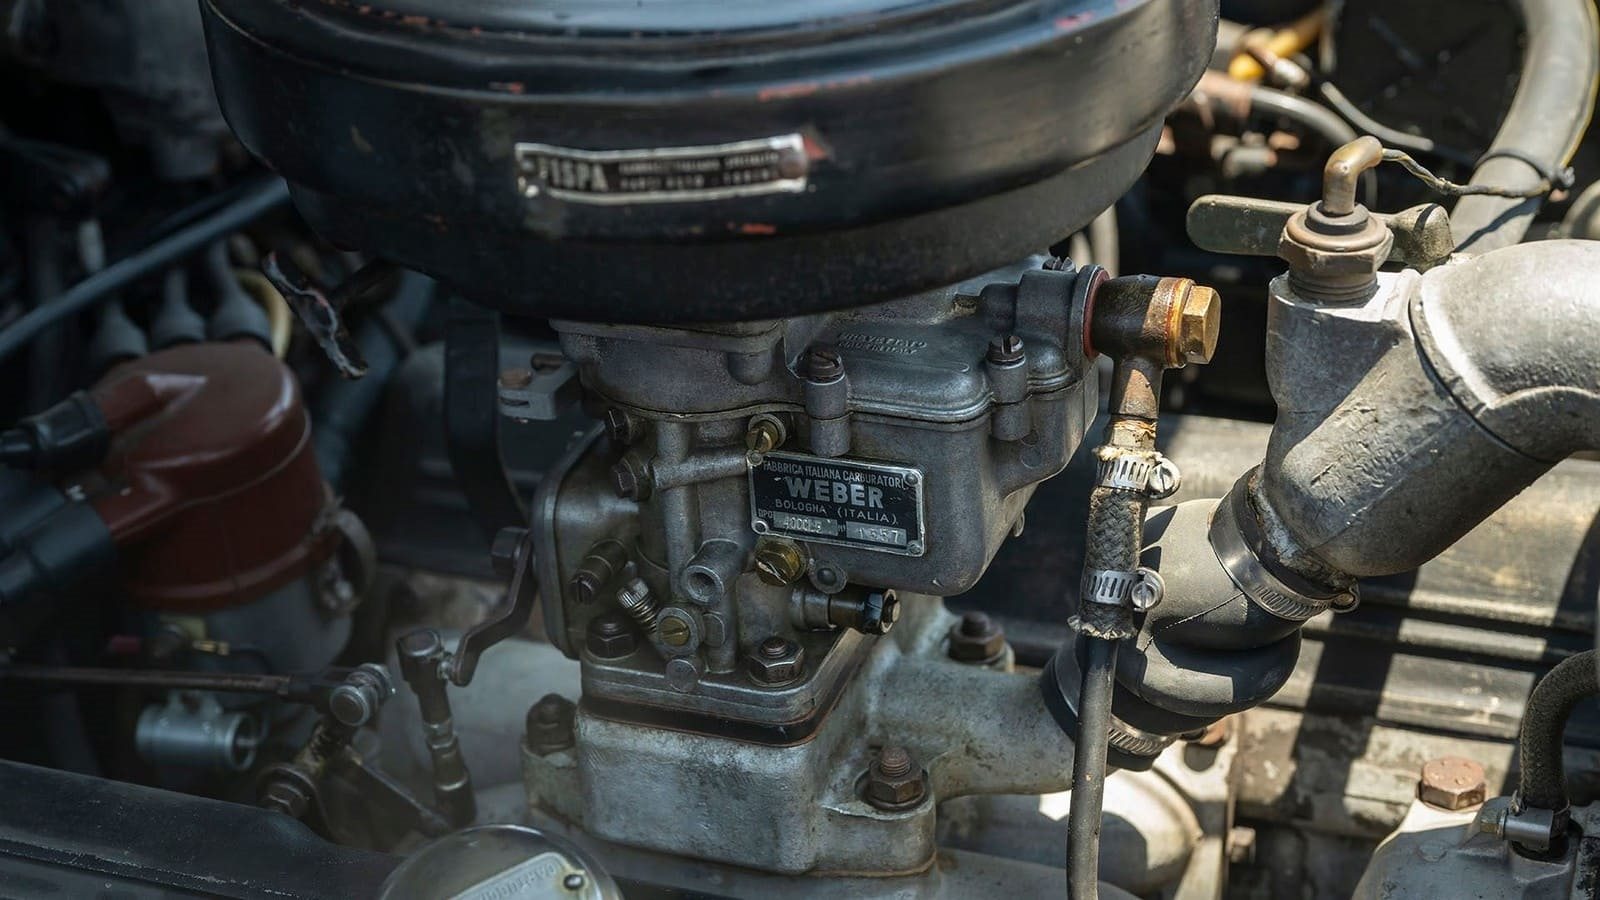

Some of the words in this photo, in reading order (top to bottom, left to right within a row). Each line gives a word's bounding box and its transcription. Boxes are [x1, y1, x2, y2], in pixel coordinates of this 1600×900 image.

[762, 461, 803, 476] FABBRICA
[805, 465, 841, 480] ITALIANA
[785, 477, 884, 509] WEBER
[775, 498, 827, 514] BOLOGNA
[837, 506, 897, 525] (ITALIA)
